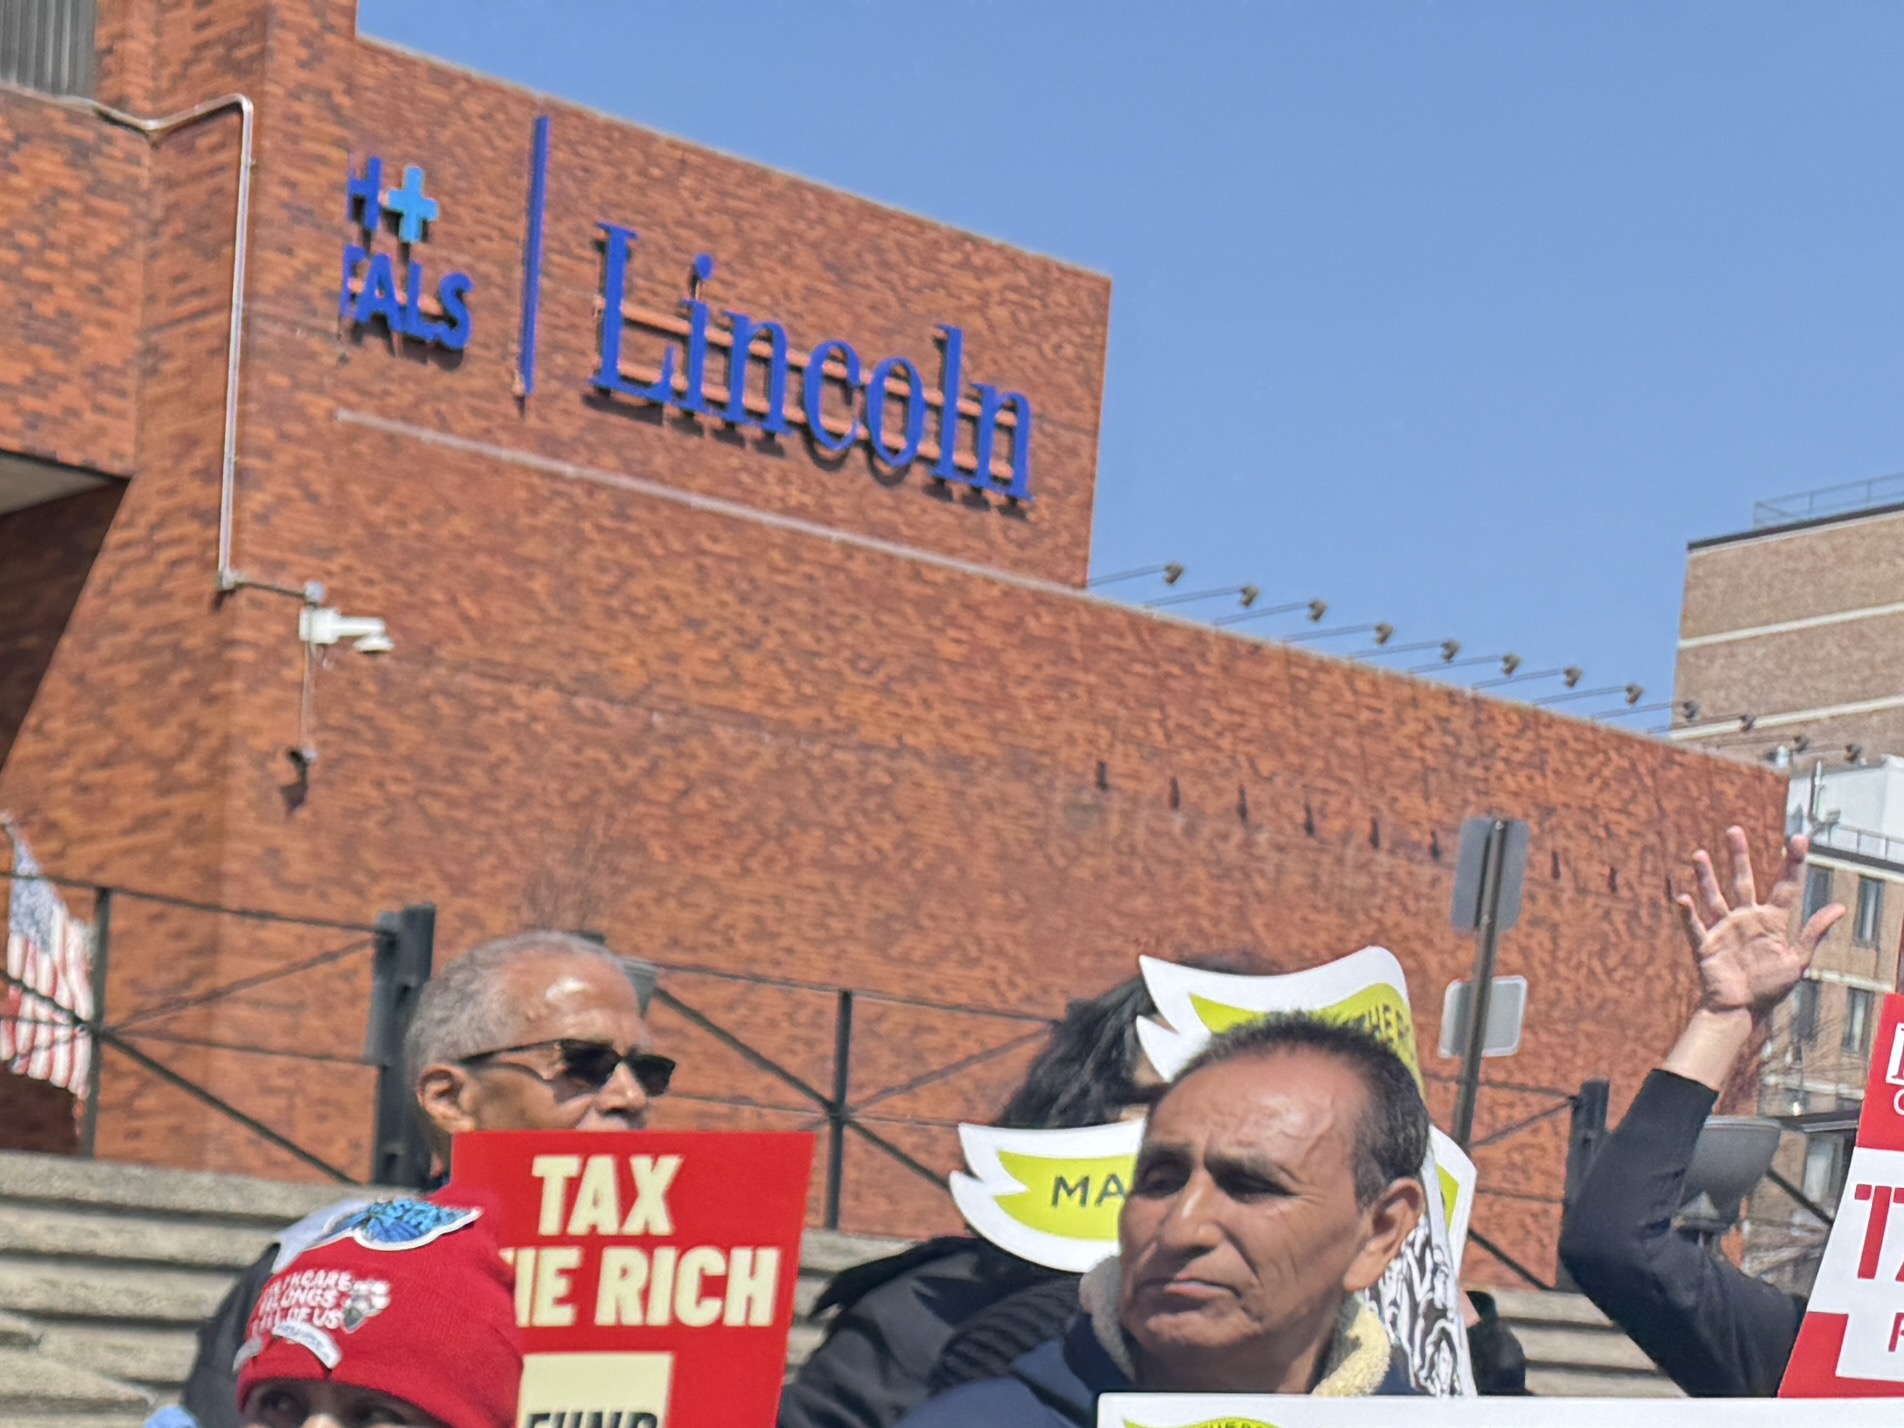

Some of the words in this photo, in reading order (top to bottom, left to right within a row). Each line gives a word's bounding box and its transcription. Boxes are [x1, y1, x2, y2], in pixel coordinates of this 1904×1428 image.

[588, 220, 1032, 503] Lincoln
[530, 1154, 684, 1237] TAX
[1051, 1173, 1126, 1208] MA
[594, 1246, 782, 1327] RICH
